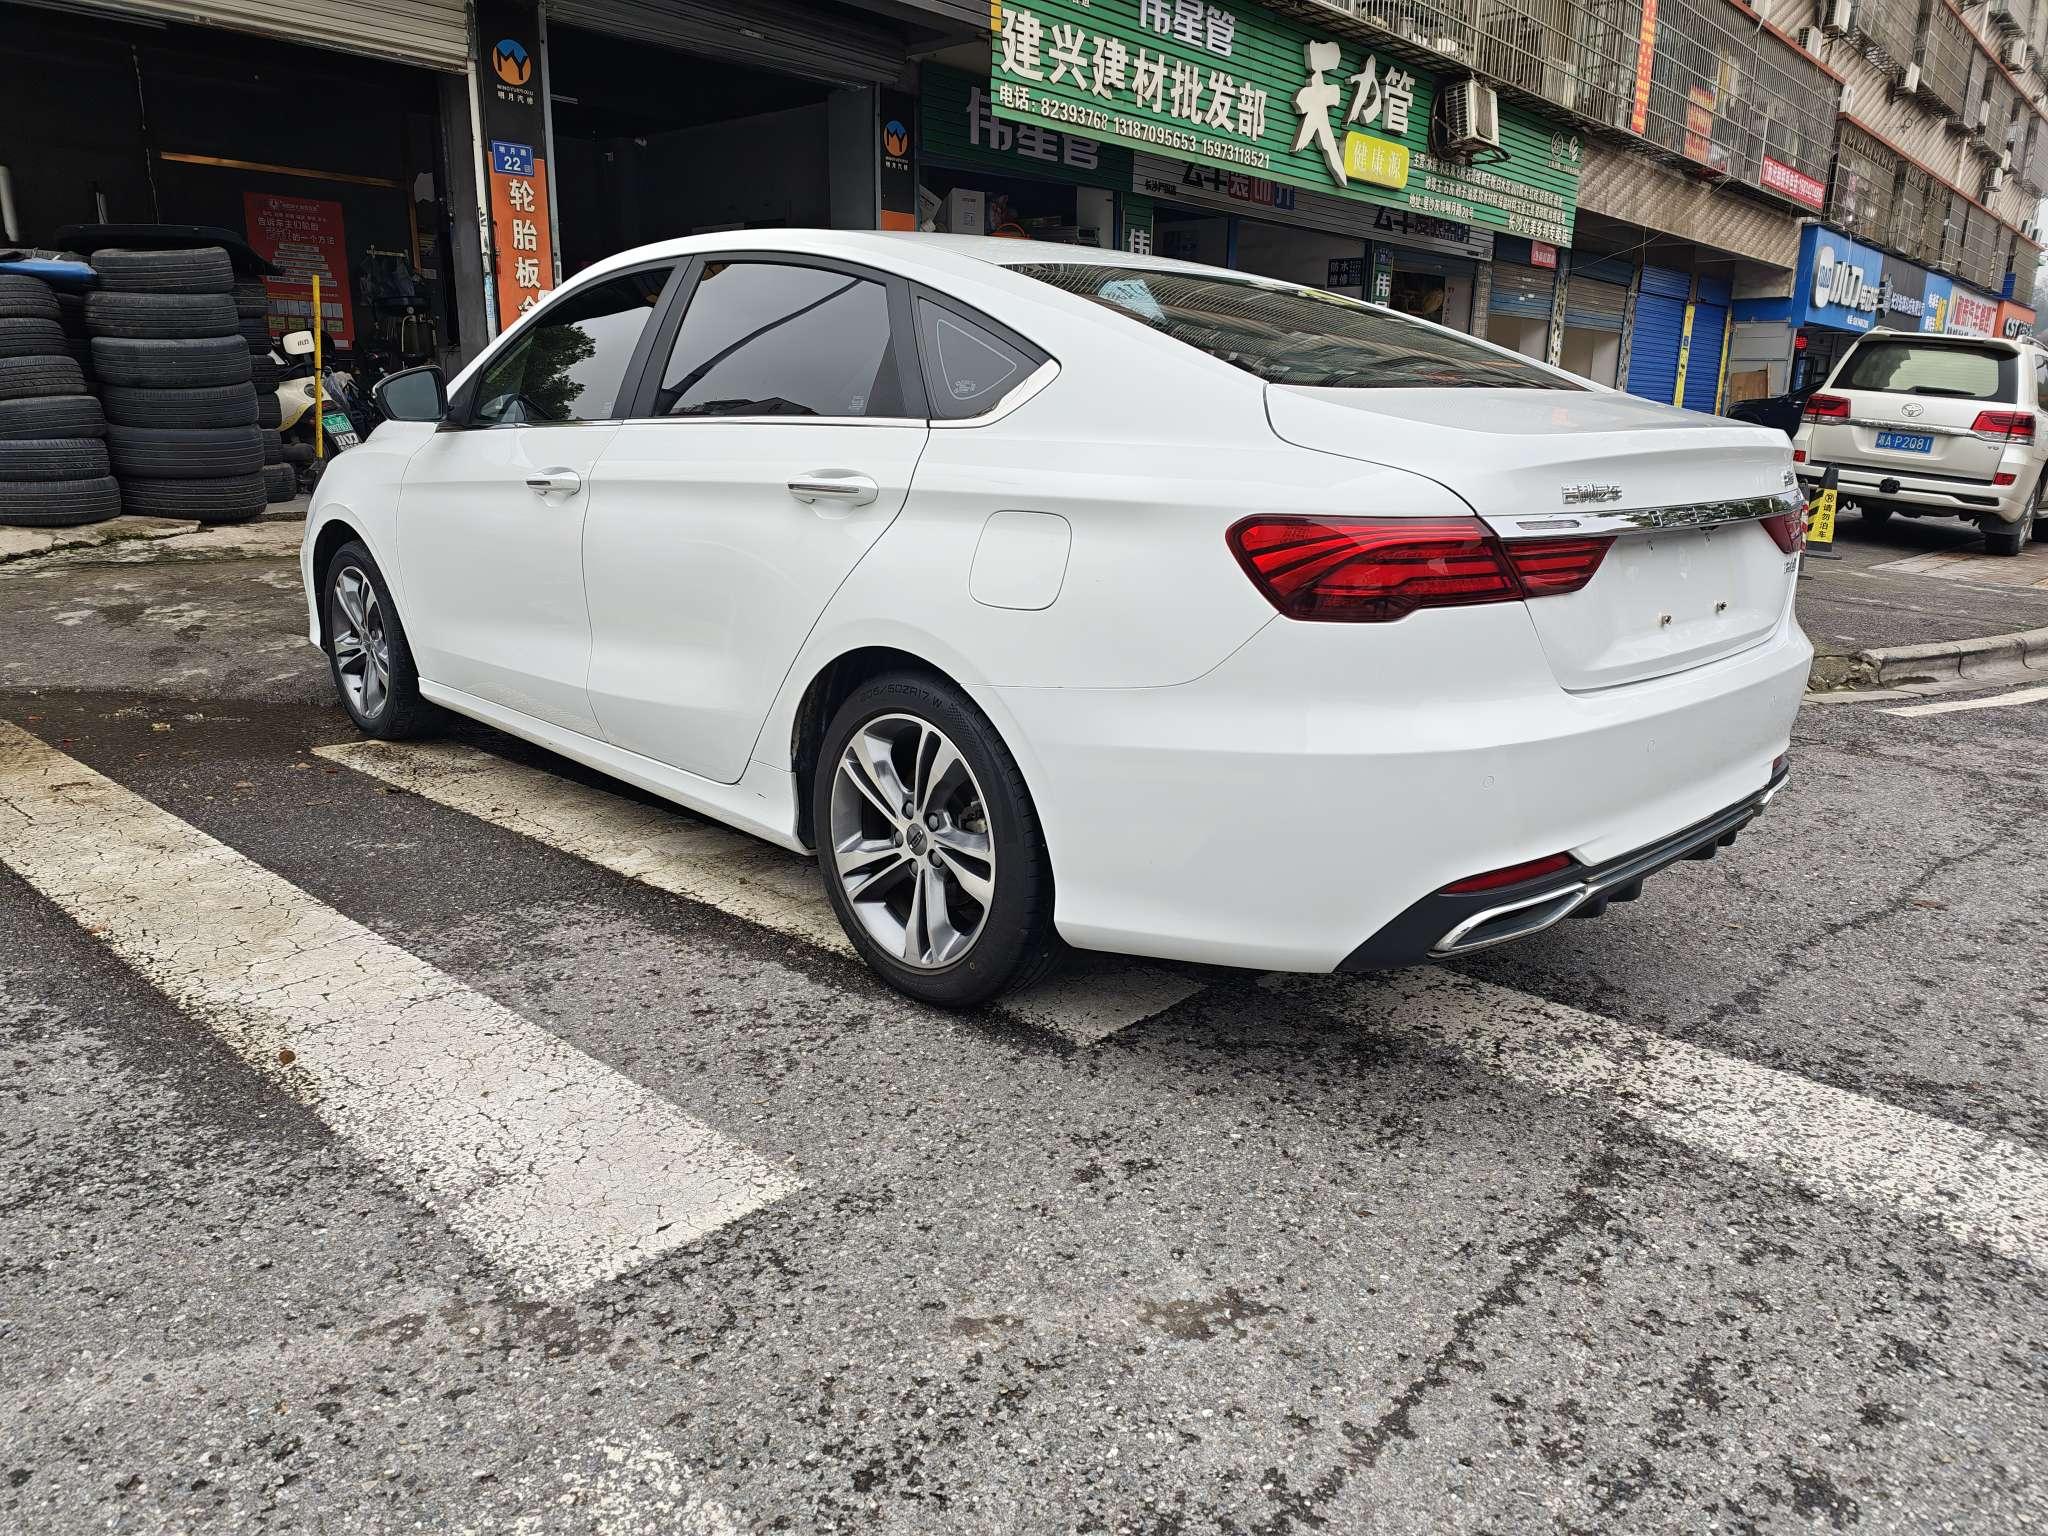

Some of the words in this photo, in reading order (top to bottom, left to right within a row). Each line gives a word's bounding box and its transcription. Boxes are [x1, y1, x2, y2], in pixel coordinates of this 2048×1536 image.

[1138, 0, 1237, 57] 伟星管
[1000, 8, 1267, 142] 建兴建材批发部
[1040, 98, 1109, 131] 82393768
[1113, 116, 1197, 152] 13187095653
[1202, 138, 1270, 169] 15973118521
[1290, 40, 1416, 188] 天力管
[1352, 140, 1402, 188] 健康源
[1818, 503, 1833, 538] 请勿泊车
